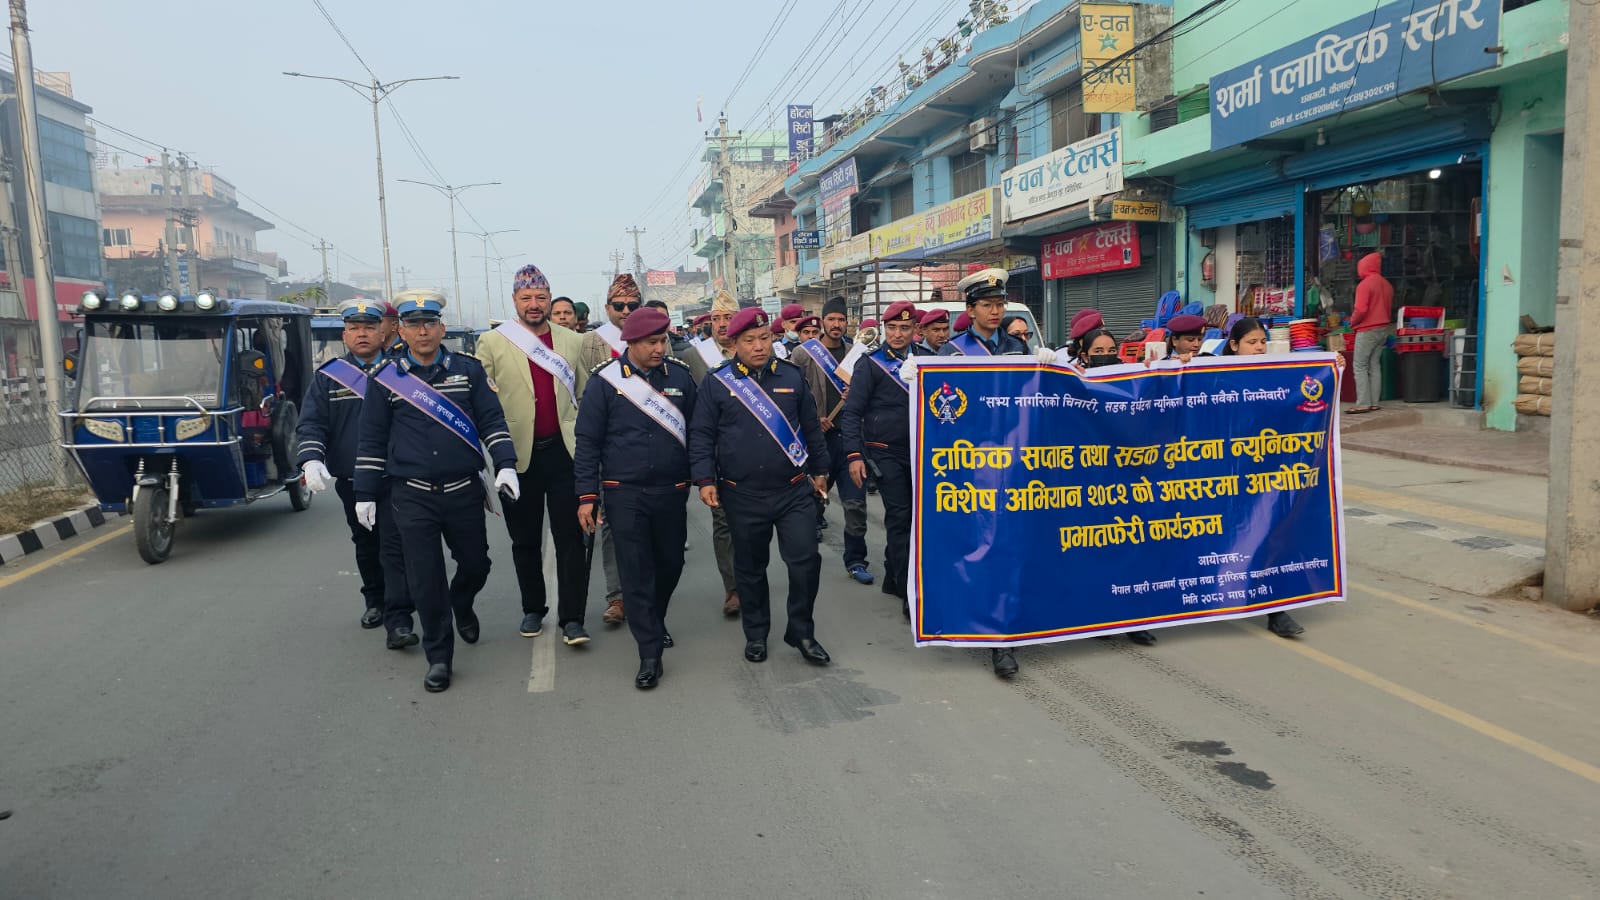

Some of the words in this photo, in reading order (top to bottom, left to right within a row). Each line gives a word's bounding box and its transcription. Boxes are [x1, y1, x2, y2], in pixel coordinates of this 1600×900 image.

[1081, 14, 1130, 32] ए-वन
[1215, 64, 1263, 118] शर्मा
[1269, 22, 1392, 95] प्लाष्टिक
[790, 105, 812, 119] होटल
[792, 121, 811, 135] सिटी
[1003, 164, 1044, 198] ए-वन
[1063, 131, 1118, 177] टेलर्स
[1043, 238, 1073, 259] ए-वन
[1095, 221, 1131, 249] टेलर्स
[411, 389, 437, 406] ट्राफिक
[454, 417, 470, 433] २०८२
[1105, 401, 1128, 413] सडक
[1186, 393, 1207, 408] हामी
[931, 439, 1013, 477] ट्राफिक
[1020, 445, 1075, 471] सप्ताह
[1079, 445, 1111, 467] तथा
[1114, 444, 1160, 468] सडक
[1163, 435, 1225, 470] दुर्घटना
[1230, 427, 1326, 463] न्यूनिकरण
[935, 481, 998, 514] विशेष
[1005, 480, 1083, 511] अभियान
[1087, 483, 1129, 507] २०८२
[1130, 475, 1155, 503] को
[1156, 475, 1239, 502] अवसरमा
[1245, 462, 1320, 495] आयोजित
[1059, 515, 1144, 552] प्रभातफेरी
[1148, 511, 1223, 541] कार्यक्रम
[1111, 584, 1131, 595] नेपाल
[1133, 580, 1150, 594] प्रहरी
[1151, 577, 1176, 592] राजमार्ग
[1178, 577, 1198, 590] सुरक्षा
[1199, 575, 1215, 585] तथा
[1217, 570, 1247, 587] ट्राफिक
[1280, 561, 1304, 574] कार्यालय
[1182, 594, 1199, 605] मिति
[1201, 592, 1225, 604] २०८२
[1227, 590, 1246, 600] माघ
